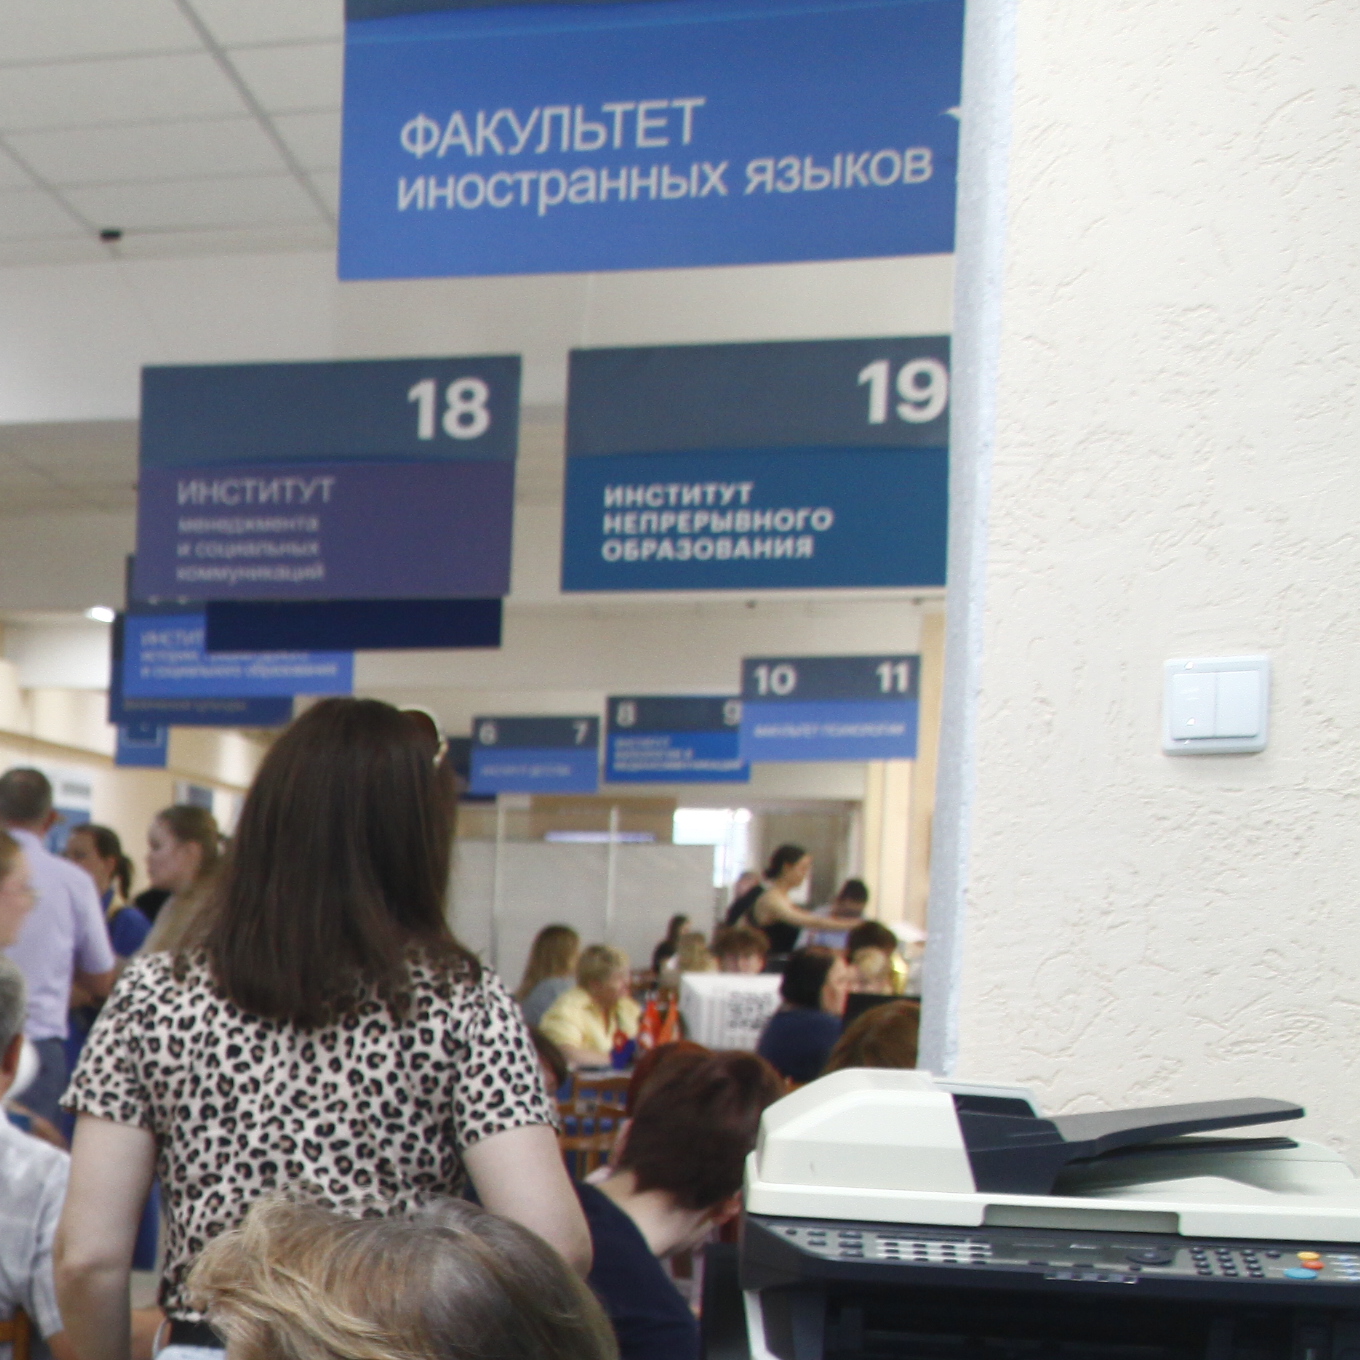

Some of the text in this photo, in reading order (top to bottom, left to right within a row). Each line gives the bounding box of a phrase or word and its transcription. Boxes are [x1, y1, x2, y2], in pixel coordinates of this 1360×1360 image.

[399, 97, 706, 158] ФАКУЛЬТЕТ
[397, 161, 728, 216] иностранных
[857, 357, 949, 424] 19
[407, 376, 491, 440] 18
[178, 476, 335, 505] ИНСТИТУТ
[603, 481, 755, 508] ИНСТИТУТ
[602, 507, 835, 535] НЕПРЕРЫВНОГО
[601, 534, 815, 562] ОБРАЗОВАНИЯ
[754, 661, 910, 696] 10 11
[573, 720, 589, 745] 7
